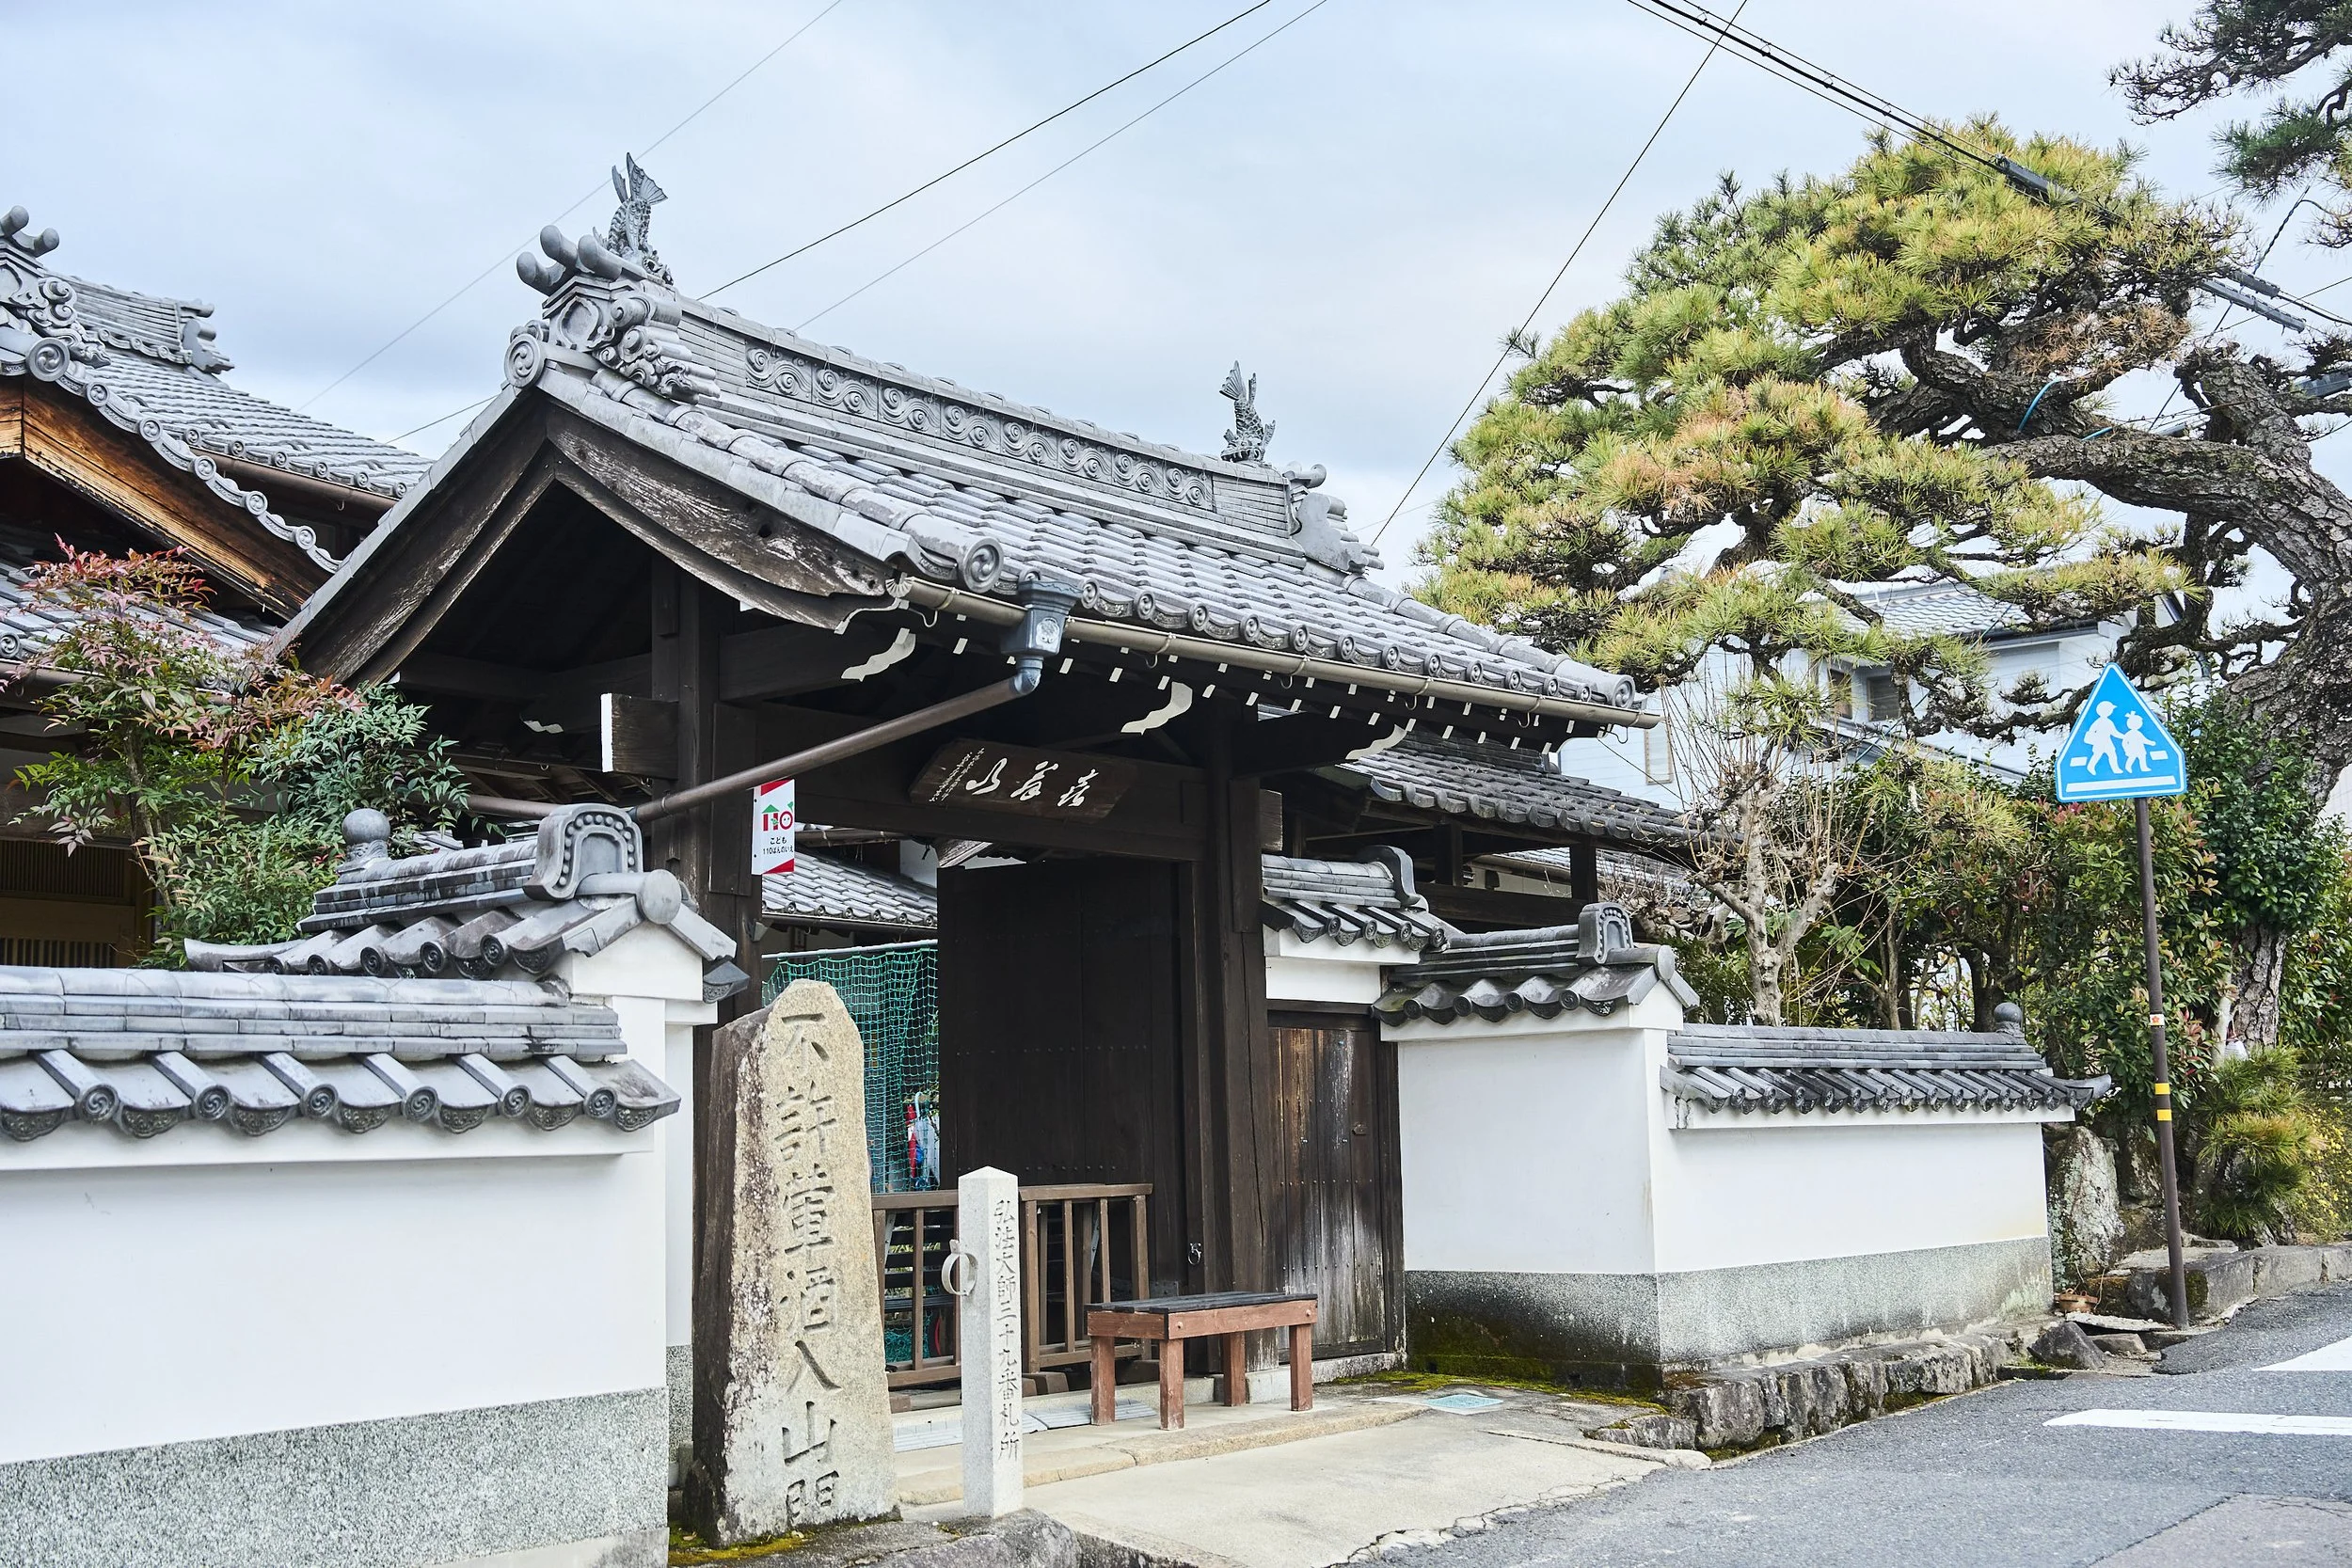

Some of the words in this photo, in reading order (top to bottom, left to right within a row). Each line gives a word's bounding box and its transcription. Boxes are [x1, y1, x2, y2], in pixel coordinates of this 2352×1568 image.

[770, 836, 787, 845] こども
[762, 846, 794, 855] 110ばんのいえ
[993, 1199, 1019, 1463] 弘法大師三十九番札所
